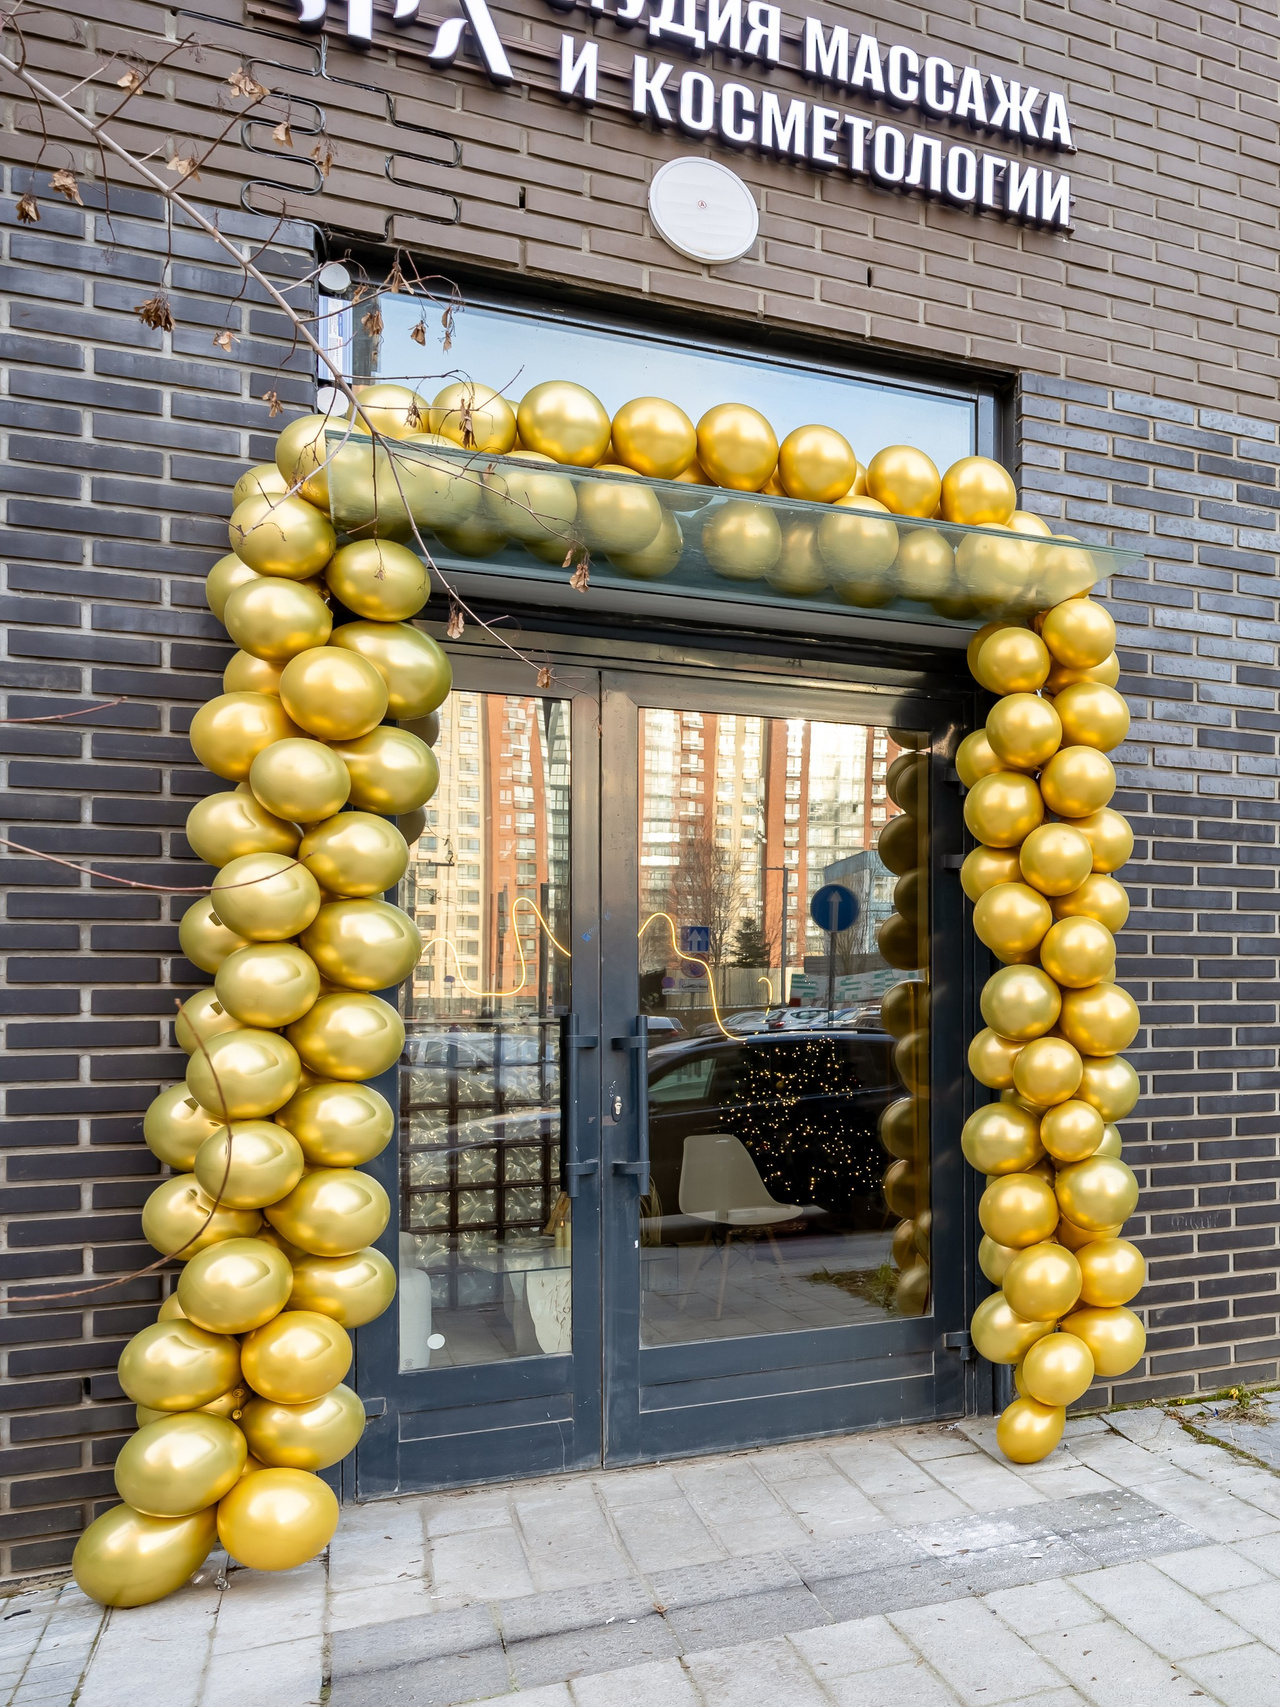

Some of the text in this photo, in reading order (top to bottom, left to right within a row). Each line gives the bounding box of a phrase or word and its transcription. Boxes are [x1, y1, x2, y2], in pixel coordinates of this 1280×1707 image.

[560, 0, 781, 62] ДИЯ
[804, 15, 1074, 148] МАССАЖА
[560, 33, 599, 101] И
[632, 54, 1072, 227] КОСМЕТОЛОГИИ
